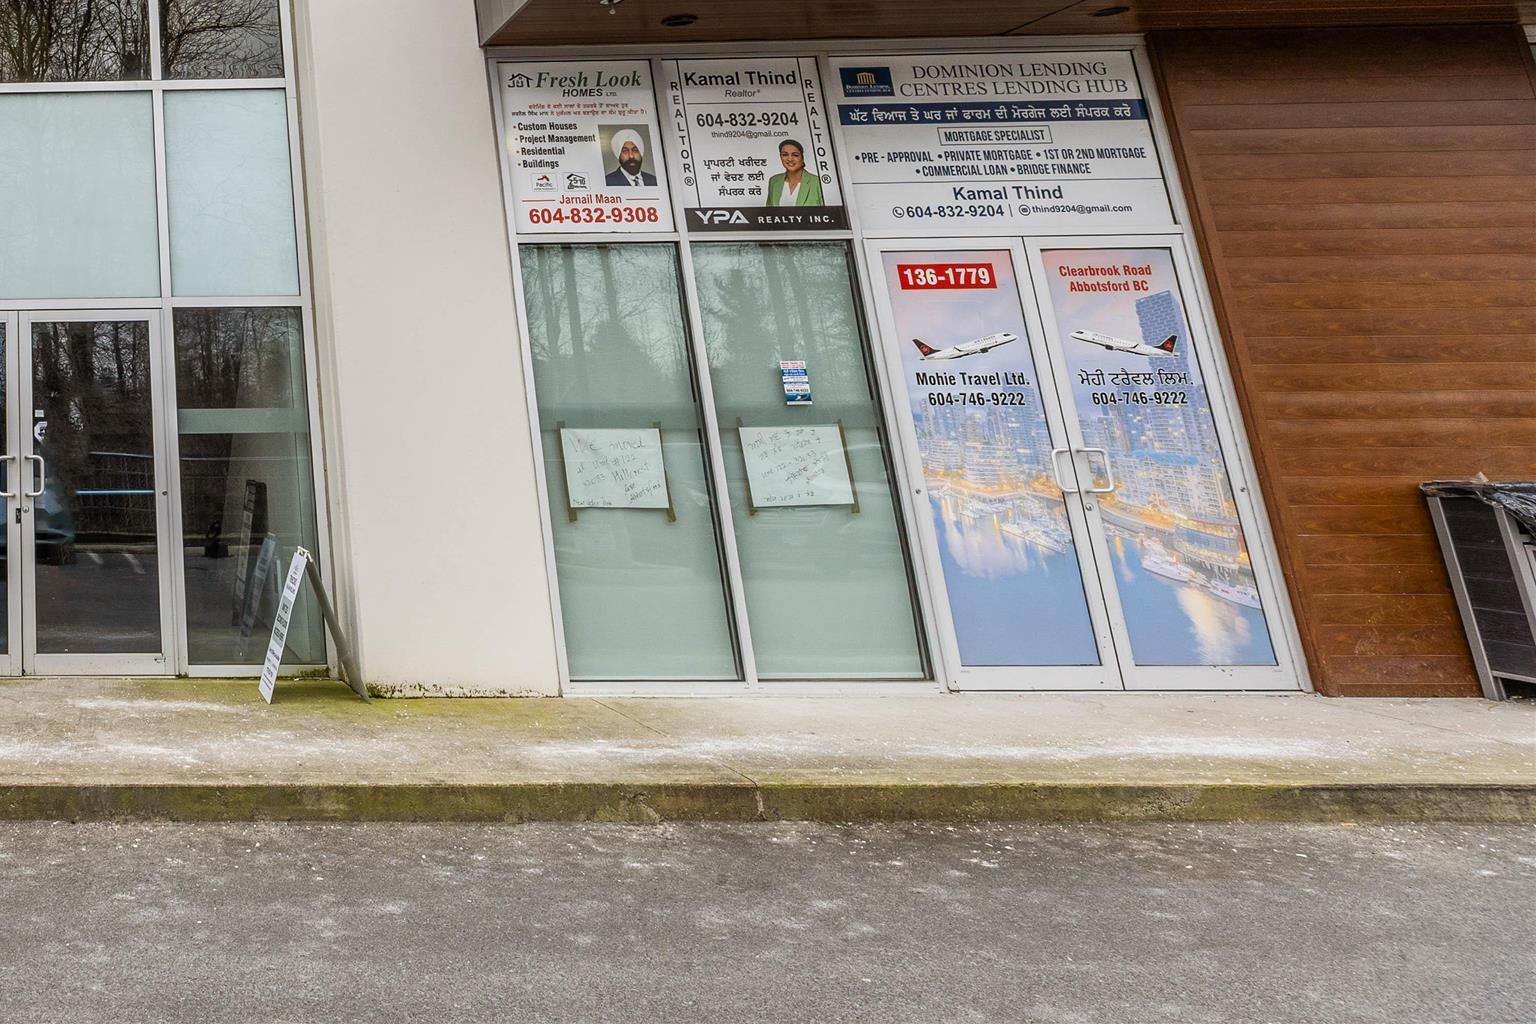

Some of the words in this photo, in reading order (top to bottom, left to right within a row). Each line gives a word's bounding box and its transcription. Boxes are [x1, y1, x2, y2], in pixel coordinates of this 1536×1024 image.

[911, 64, 1014, 79] DOMINION
[1019, 62, 1107, 77] LENDING
[535, 71, 588, 89] Fresh
[596, 70, 642, 88] Look
[684, 71, 740, 86] Kamal
[744, 70, 797, 85] Thind
[562, 88, 604, 97] HOMES
[900, 82, 988, 97] CENTRES
[992, 80, 1080, 95] LENDING
[1085, 79, 1129, 93] HUB
[517, 123, 547, 131] Custom
[549, 122, 578, 130] Houses
[696, 112, 799, 127] 604-832-9204
[520, 135, 546, 144] Project
[548, 134, 597, 144] Management
[711, 130, 789, 139] thind9204@gmail.com
[944, 130, 993, 142] MORTGAGE
[994, 129, 1045, 141] SPECIALIST
[521, 147, 565, 156] Residential
[861, 152, 880, 163] PRE
[887, 151, 934, 163] APPROVAL
[944, 150, 982, 162] PRIVATE
[983, 149, 1033, 161] MORTGAGE
[1043, 149, 1060, 160] 1ST
[1062, 149, 1075, 159] OR
[1076, 148, 1095, 159] 2ND
[1097, 147, 1147, 159] MORTGAGE
[522, 160, 559, 169] Buildings
[922, 165, 983, 176] COMMERCIAL
[985, 164, 1008, 175] LOAN
[1017, 164, 1050, 175] BRIDGE
[1052, 163, 1092, 174] FINANCE
[559, 195, 593, 205] Jarnail
[595, 194, 622, 204] Maan
[952, 186, 1008, 200] Kamal
[1012, 185, 1064, 199] Thind
[529, 207, 659, 224] 604-832-9308
[695, 209, 750, 225] YPA
[757, 216, 803, 224] REALTY
[809, 215, 835, 223] INC.
[906, 205, 1004, 218] 604-832-9204
[1031, 204, 1133, 214] thind9204@gmail.com
[904, 267, 991, 286] 136-1779
[1059, 265, 1120, 277] Clearbrook
[1124, 264, 1152, 276] Road
[1070, 280, 1130, 292] Abbotsford
[1133, 280, 1149, 291] BC
[915, 372, 956, 386] Mohie
[959, 372, 1001, 386] Travel
[1004, 371, 1030, 385] Ltd.
[928, 392, 1025, 406] 604-746-9222
[1092, 391, 1188, 405] 604-746-9222
